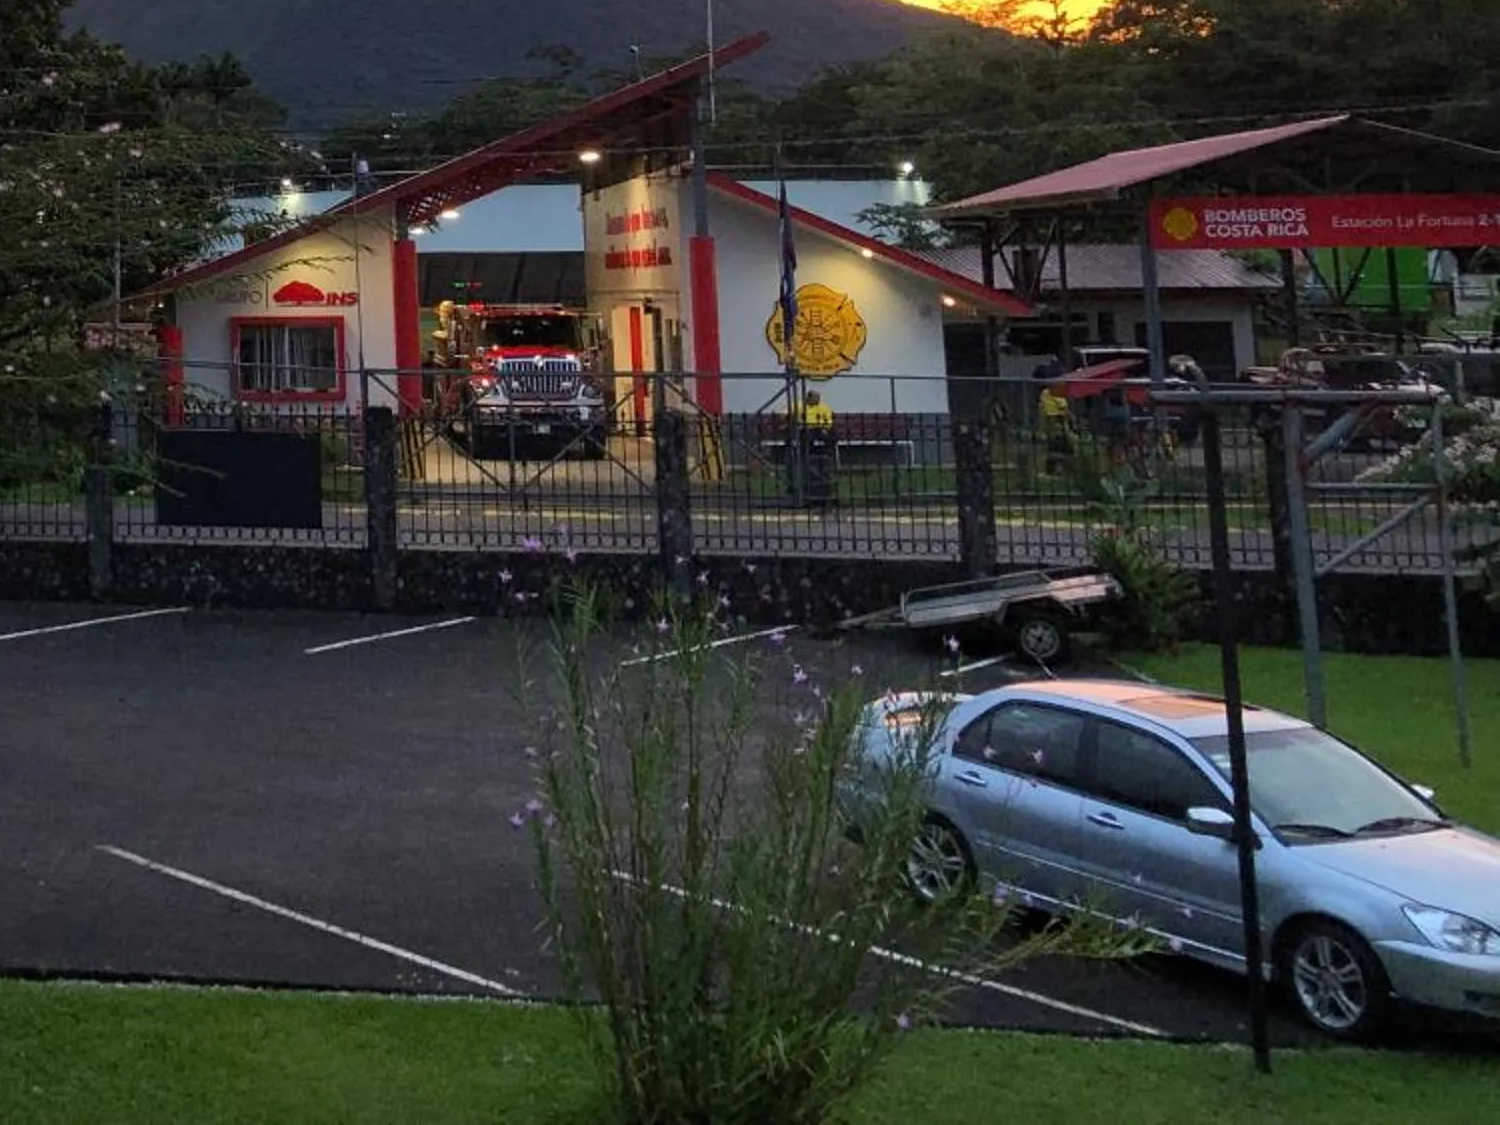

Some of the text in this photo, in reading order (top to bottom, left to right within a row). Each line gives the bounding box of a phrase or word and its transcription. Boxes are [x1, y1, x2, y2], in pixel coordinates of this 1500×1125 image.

[1204, 208, 1306, 223] BOMBEROS
[1331, 215, 1393, 228] Estación
[1418, 213, 1475, 227] Fortuna
[1205, 223, 1309, 237] COSTA RICA
[325, 292, 358, 306] INS
